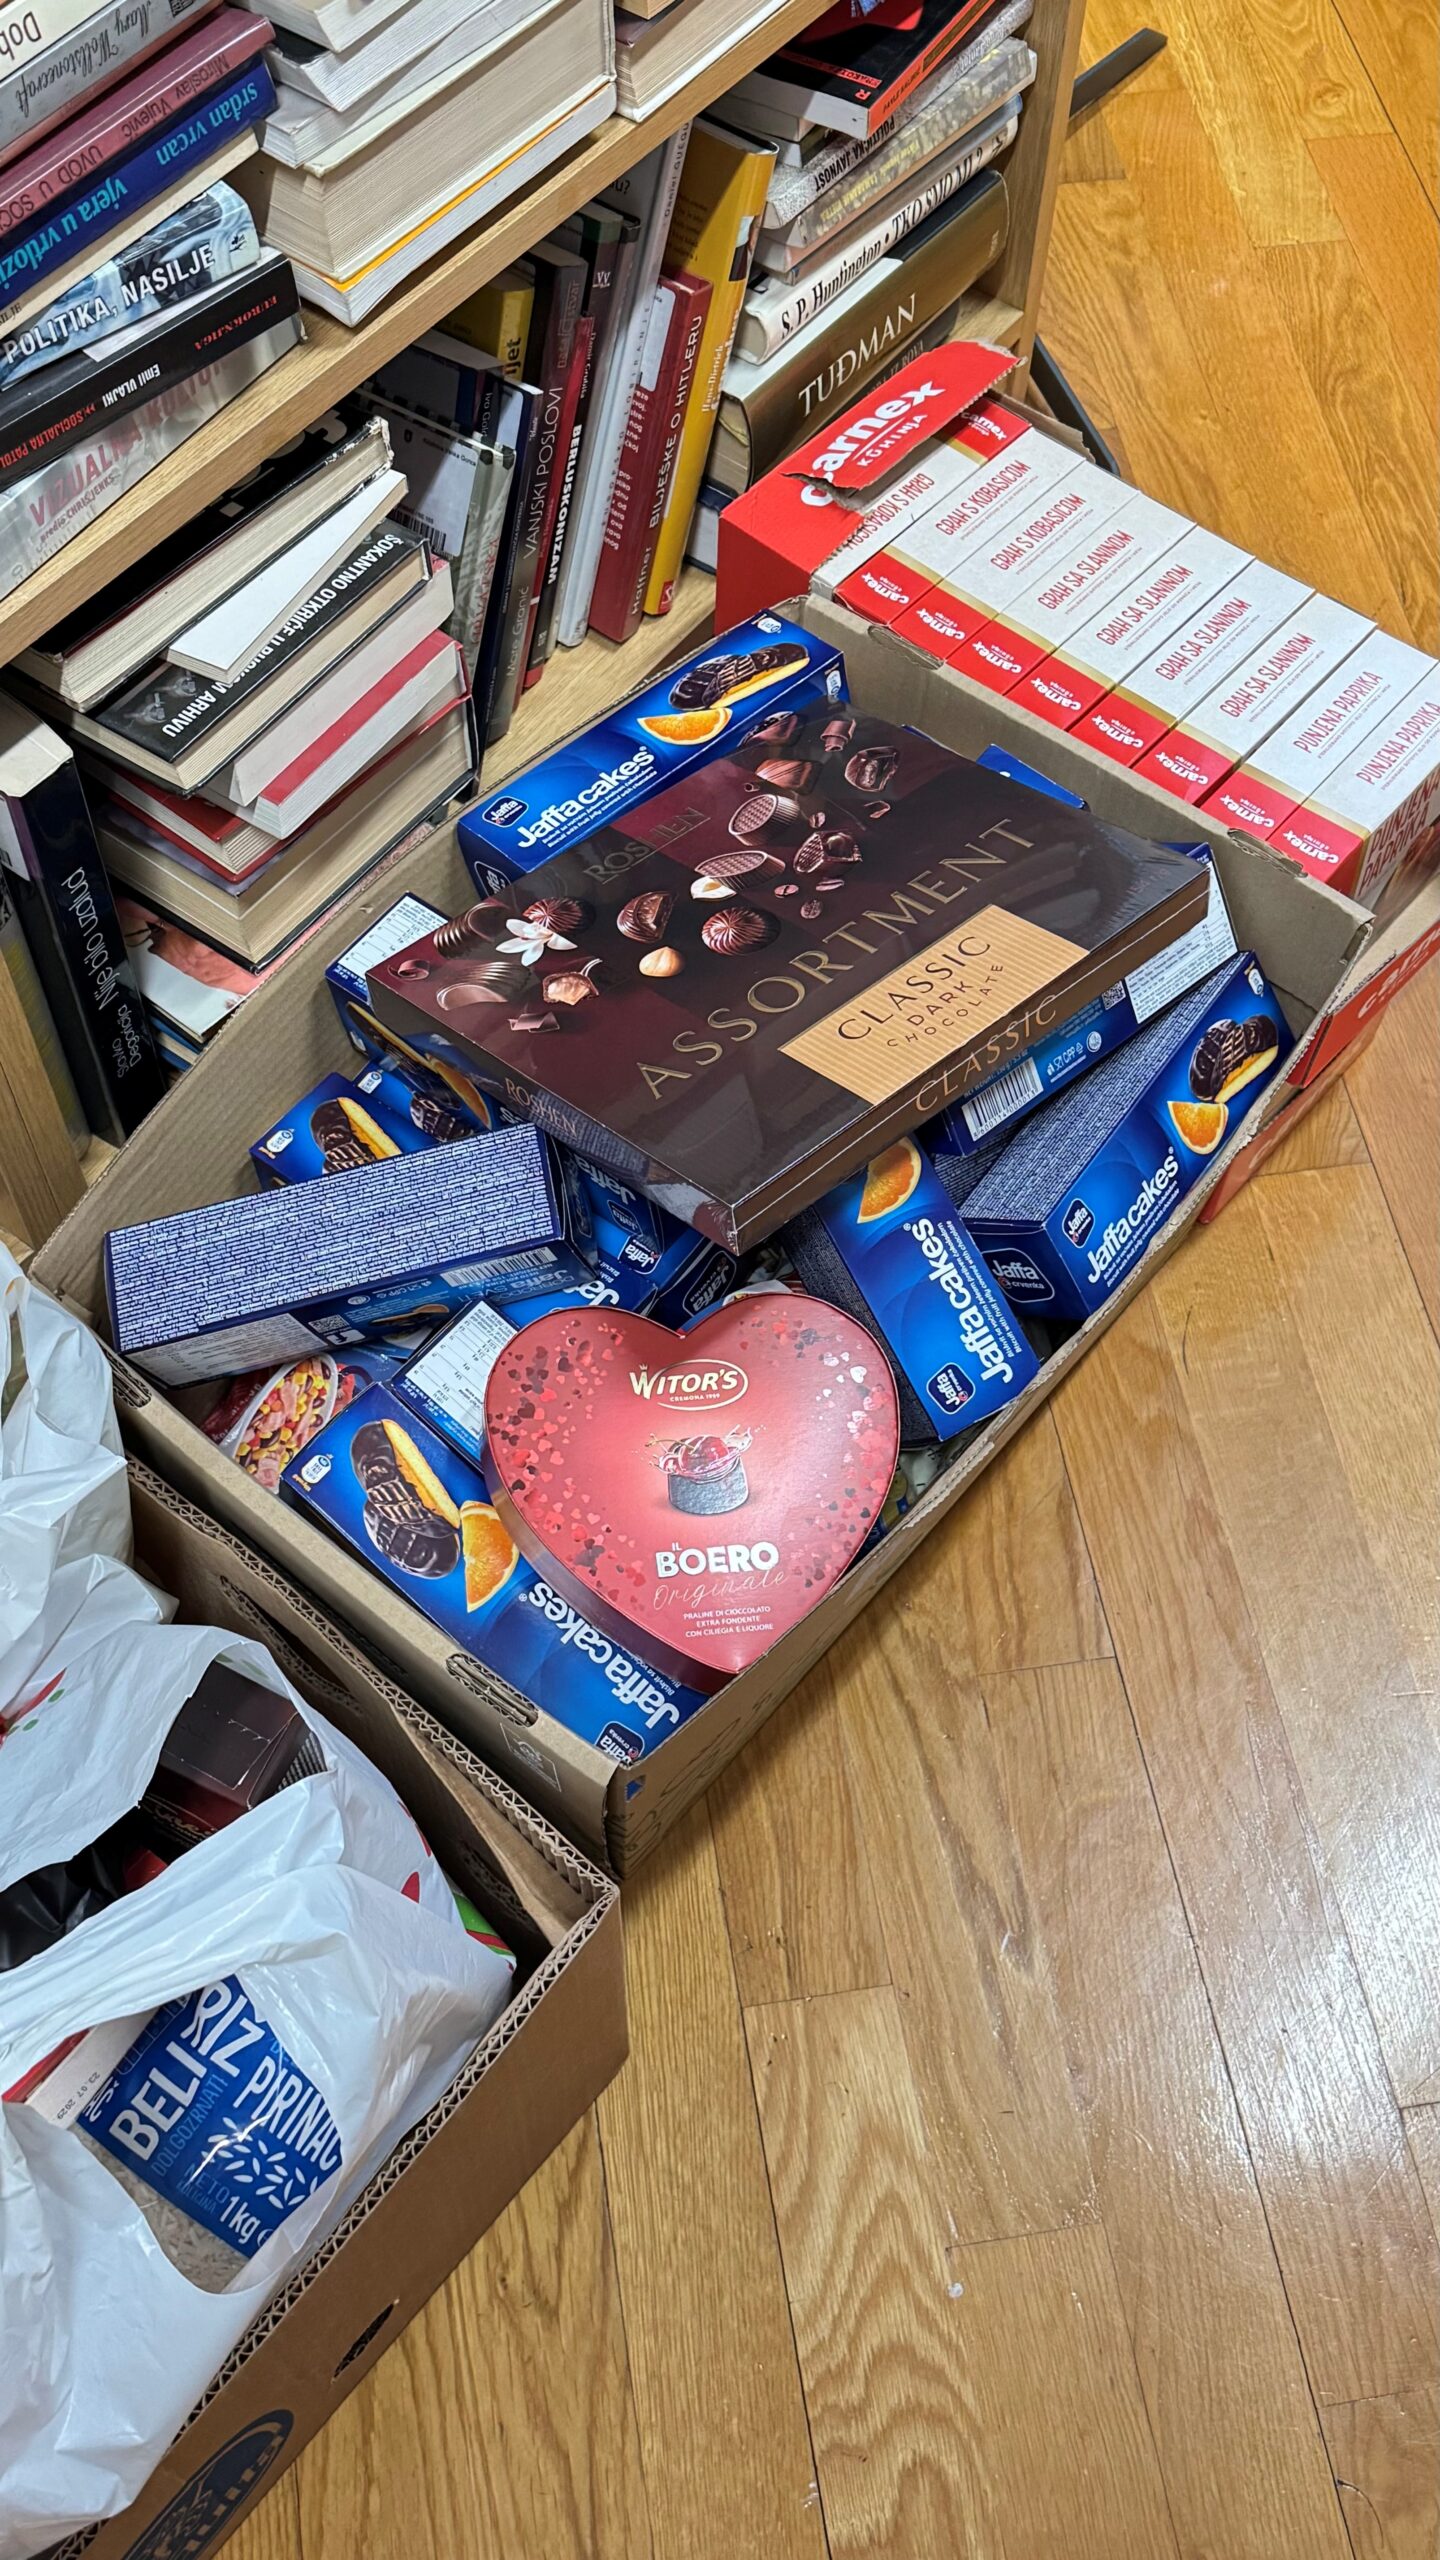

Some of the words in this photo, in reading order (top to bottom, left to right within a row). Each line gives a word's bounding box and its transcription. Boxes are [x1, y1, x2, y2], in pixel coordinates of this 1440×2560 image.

[115, 1, 151, 38] Mary
[15, 34, 120, 118] Wollstonecraft
[175, 53, 229, 100] Miroslav
[121, 97, 173, 143] Vujević
[209, 82, 258, 128] srđan
[57, 145, 104, 185] UVOD
[156, 123, 208, 166] vrcan
[38, 180, 55, 199] U
[815, 143, 852, 192] JAVNOST
[77, 178, 128, 223] vjera
[62, 216, 81, 237] u
[780, 311, 794, 339] S.
[795, 298, 810, 322] P.
[812, 240, 882, 303] Huntington
[892, 204, 923, 240] TKO
[4, 297, 118, 364] POLITIKA,
[121, 243, 216, 307] NASILJE
[194, 295, 278, 351] EUROKNJIGA
[674, 315, 702, 407] HITLERU
[799, 293, 916, 417] TUĐMAN
[29, 410, 84, 448] SOCIJALNA
[670, 413, 681, 429] O
[523, 482, 548, 560] VANJSKI
[536, 387, 563, 476] POSLOVI
[649, 434, 677, 530] BILJEŠKE
[899, 473, 935, 500] GRAH
[967, 455, 1031, 512] KOBASICOM
[547, 424, 583, 585] BERLUSKONIZAM
[891, 494, 910, 507] S
[935, 504, 971, 539] GRAH
[960, 497, 979, 517] S
[1022, 489, 1086, 546] KOBASICOM
[329, 529, 403, 596] ŠOKANTNO
[990, 539, 1026, 573] GRAH
[1015, 531, 1034, 552] S
[1075, 527, 1133, 581] SLANINOM
[630, 547, 652, 616] Haffner
[861, 572, 910, 605] carnex
[1038, 579, 1076, 616] GRAH
[1063, 567, 1089, 594] SA
[916, 608, 966, 640] carnex
[1096, 614, 1134, 651] GRAH
[1121, 602, 1147, 628] SA
[1134, 561, 1191, 616] SLANINOM
[972, 641, 1022, 674] carnex
[1154, 647, 1192, 684] GRAH
[1179, 635, 1205, 661] SA
[1192, 594, 1249, 649] SLANINOM
[1031, 677, 1082, 711] carnex
[1218, 683, 1256, 720] GRAH
[1243, 671, 1269, 697] SA
[1256, 630, 1314, 685] SLANINOM
[160, 689, 217, 740] ARHIVU
[1090, 714, 1143, 749] carnex
[1291, 702, 1347, 757] PUNJENA
[1331, 664, 1383, 716] PAPRIKA
[1356, 740, 1409, 785] PUNJENA
[1395, 701, 1440, 745] PAPRIKA
[1156, 751, 1208, 786] carnex
[487, 796, 519, 822] Jaffa
[510, 791, 585, 851] Jaffa
[1219, 793, 1274, 828] carnex
[1283, 829, 1339, 865] carnex
[58, 866, 100, 935] uzalud
[76, 932, 111, 973] bilo
[638, 818, 1035, 1099] ASSORTMENT
[88, 965, 127, 1010] Nije
[839, 935, 990, 1042] CLASSIC
[886, 964, 1003, 1048] CHOCOLATE
[906, 981, 974, 1027] DARK
[914, 994, 1058, 1112] CLASSIC
[504, 1077, 578, 1138] ROSHEN
[1068, 1206, 1089, 1236] Jaffa
[625, 1243, 656, 1268] Jaffa
[992, 1259, 1039, 1281] Jaffa
[1075, 1212, 1137, 1284] Jaffa
[1011, 1280, 1045, 1291] crvenka
[960, 1308, 1014, 1384] Jaffa
[629, 1366, 738, 1401] WITOR'S
[669, 1394, 705, 1403] CREMONA
[937, 1373, 962, 1406] Jaffa
[655, 1541, 780, 1579] BOERO
[671, 1542, 682, 1552] IL
[653, 1569, 789, 1612] Originale
[683, 1611, 714, 1621] PRALINE
[715, 1609, 725, 1618] DI
[724, 1604, 772, 1617] CIOCCOLATO
[685, 1628, 703, 1639] CON
[703, 1625, 735, 1637] CILIEGIA
[742, 1622, 774, 1633] LIQUORE
[696, 1619, 720, 1629] EXTRA
[720, 1614, 761, 1626] FONDENTE
[606, 1660, 680, 1729] Jaffa
[109, 2041, 206, 2161] BELI
[150, 2072, 229, 2180] DOLGOZRNATI
[182, 2162, 231, 2204] NETO
